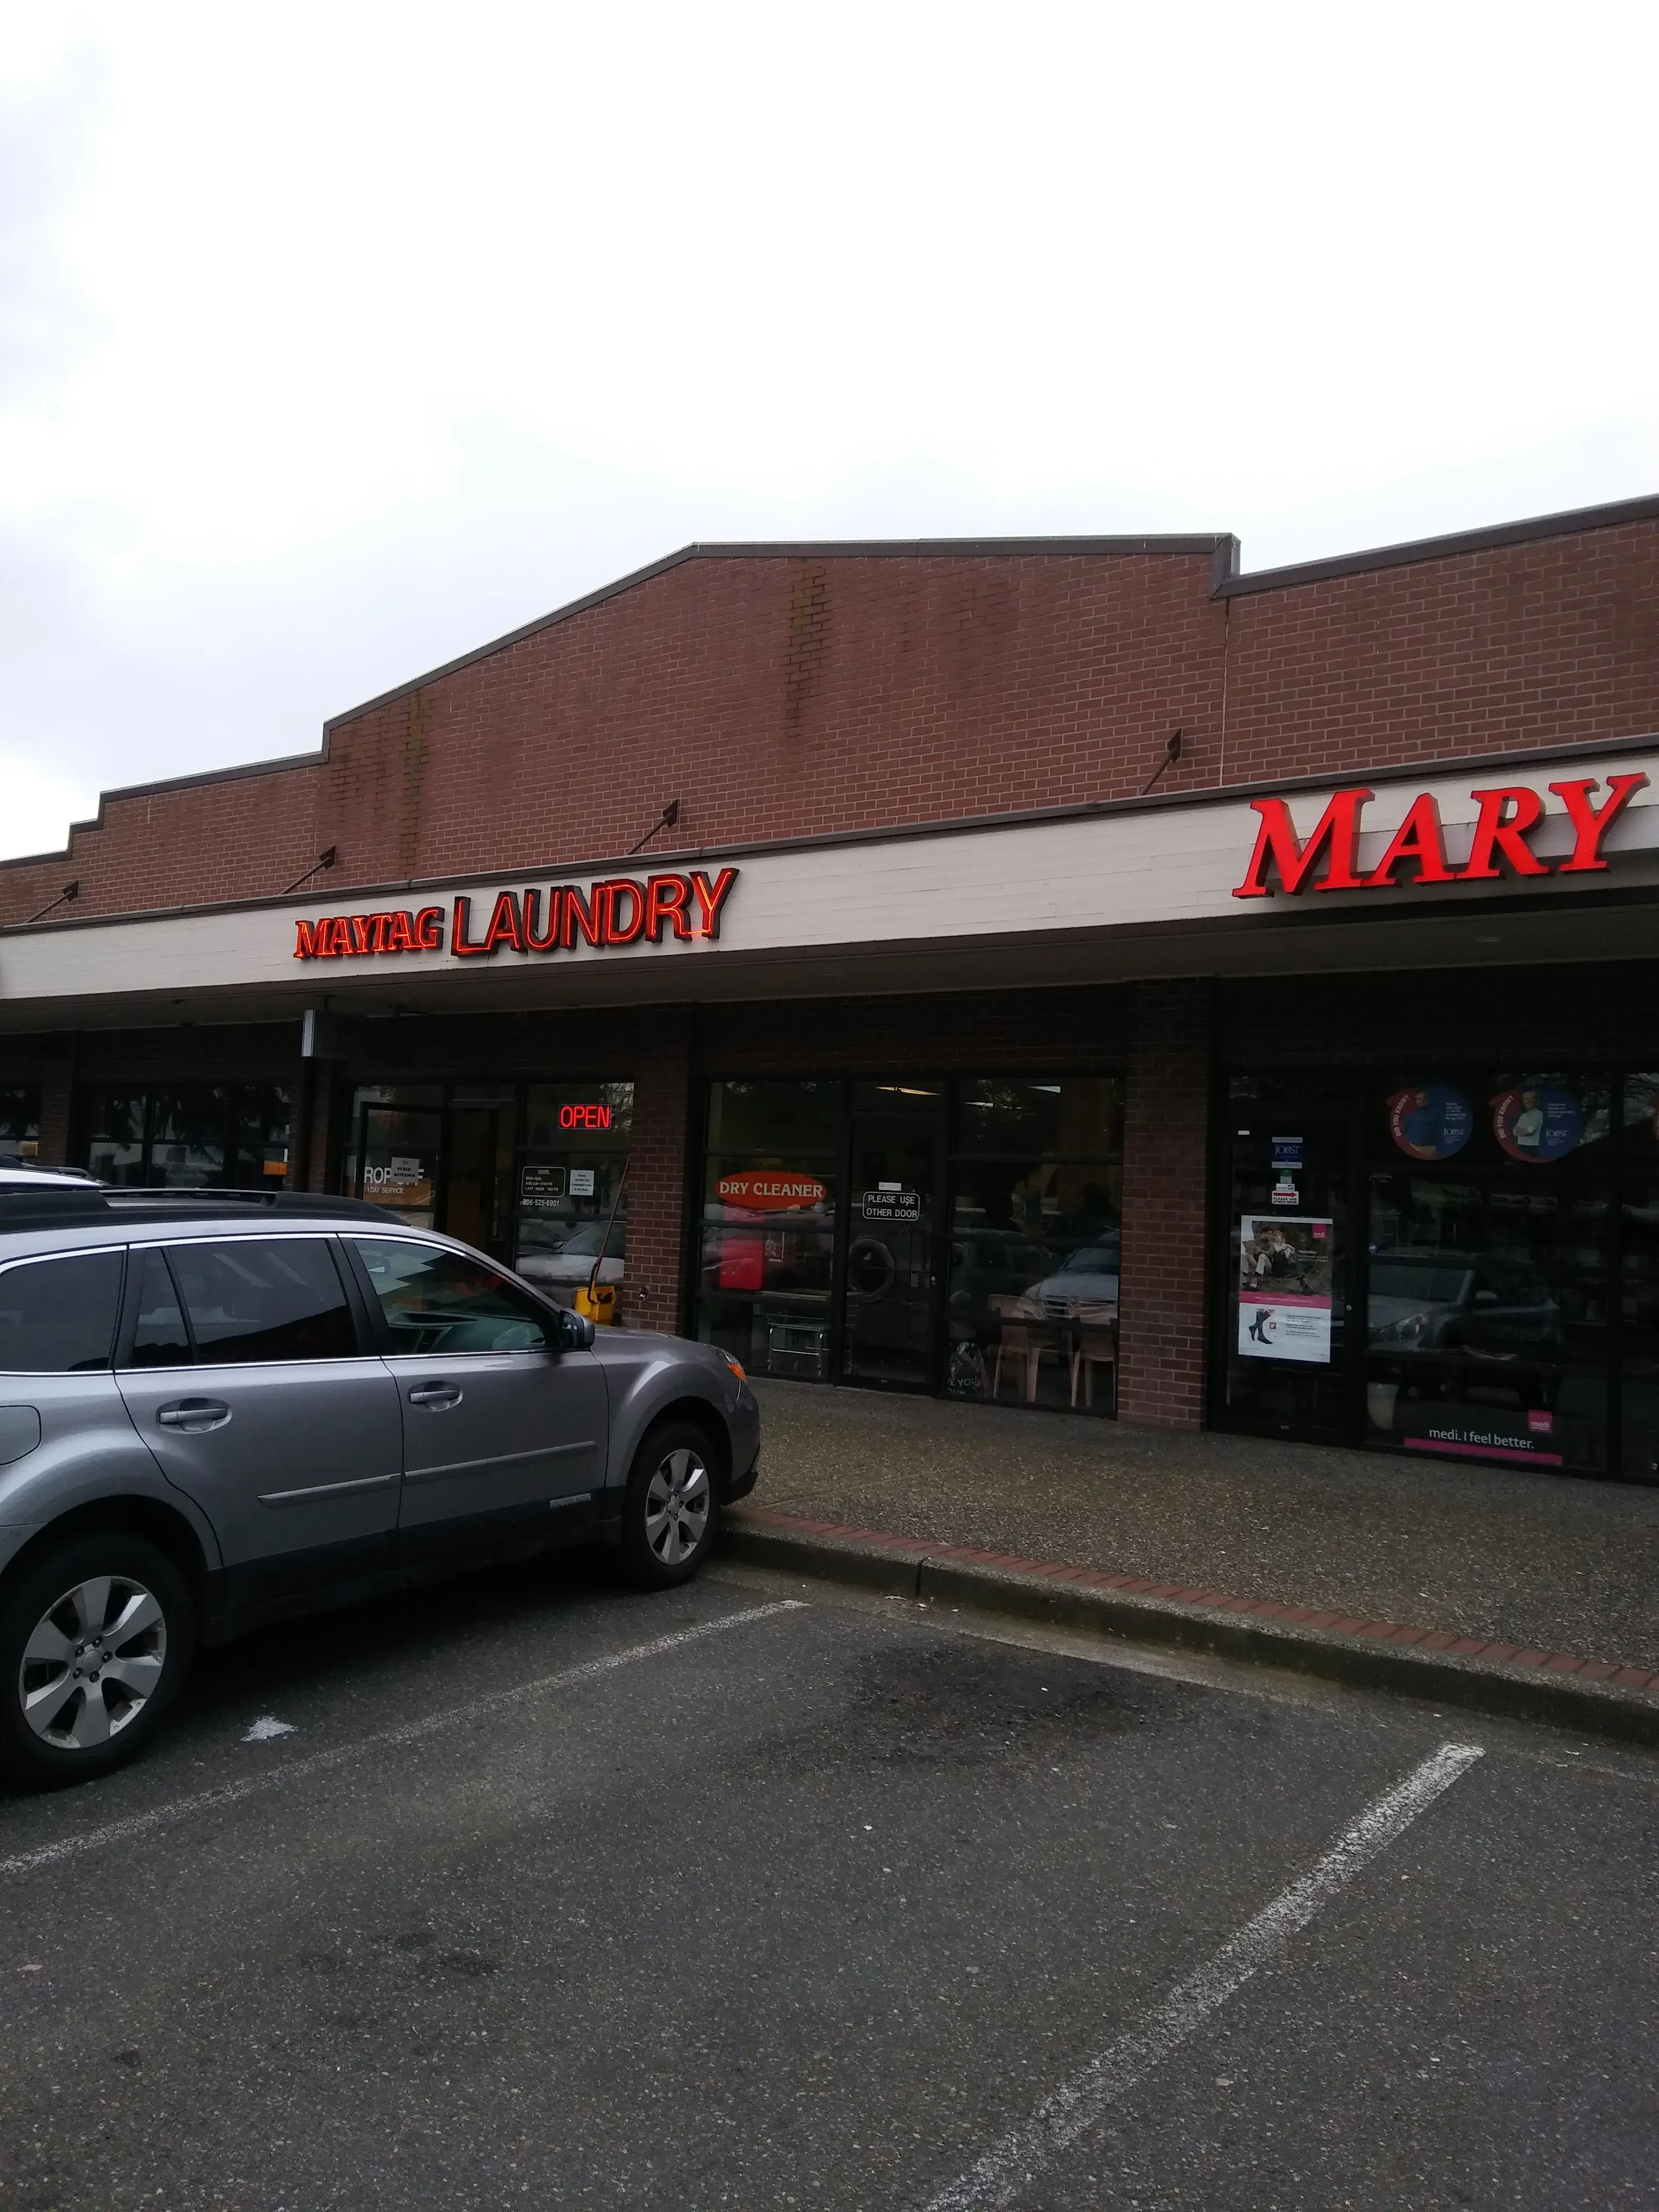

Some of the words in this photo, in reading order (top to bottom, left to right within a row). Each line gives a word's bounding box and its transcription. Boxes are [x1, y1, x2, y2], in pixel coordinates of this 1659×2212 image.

[1232, 772, 1651, 899] MARY
[294, 906, 445, 959] MAYTAG
[451, 867, 740, 957] LAUNDRY
[560, 1106, 610, 1128] OPEN
[1274, 1144, 1302, 1155] JOBST
[354, 1166, 391, 1184] ROP
[719, 1182, 749, 1195] DRY
[752, 1182, 824, 1197] CLEANER
[868, 1194, 896, 1203] PLEASE
[900, 1195, 915, 1204] USE
[867, 1208, 892, 1217] OTHER
[894, 1209, 918, 1218] DOOR
[1429, 1429, 1462, 1442] medi.
[1469, 1431, 1492, 1445] feel
[1494, 1434, 1534, 1449] better.
